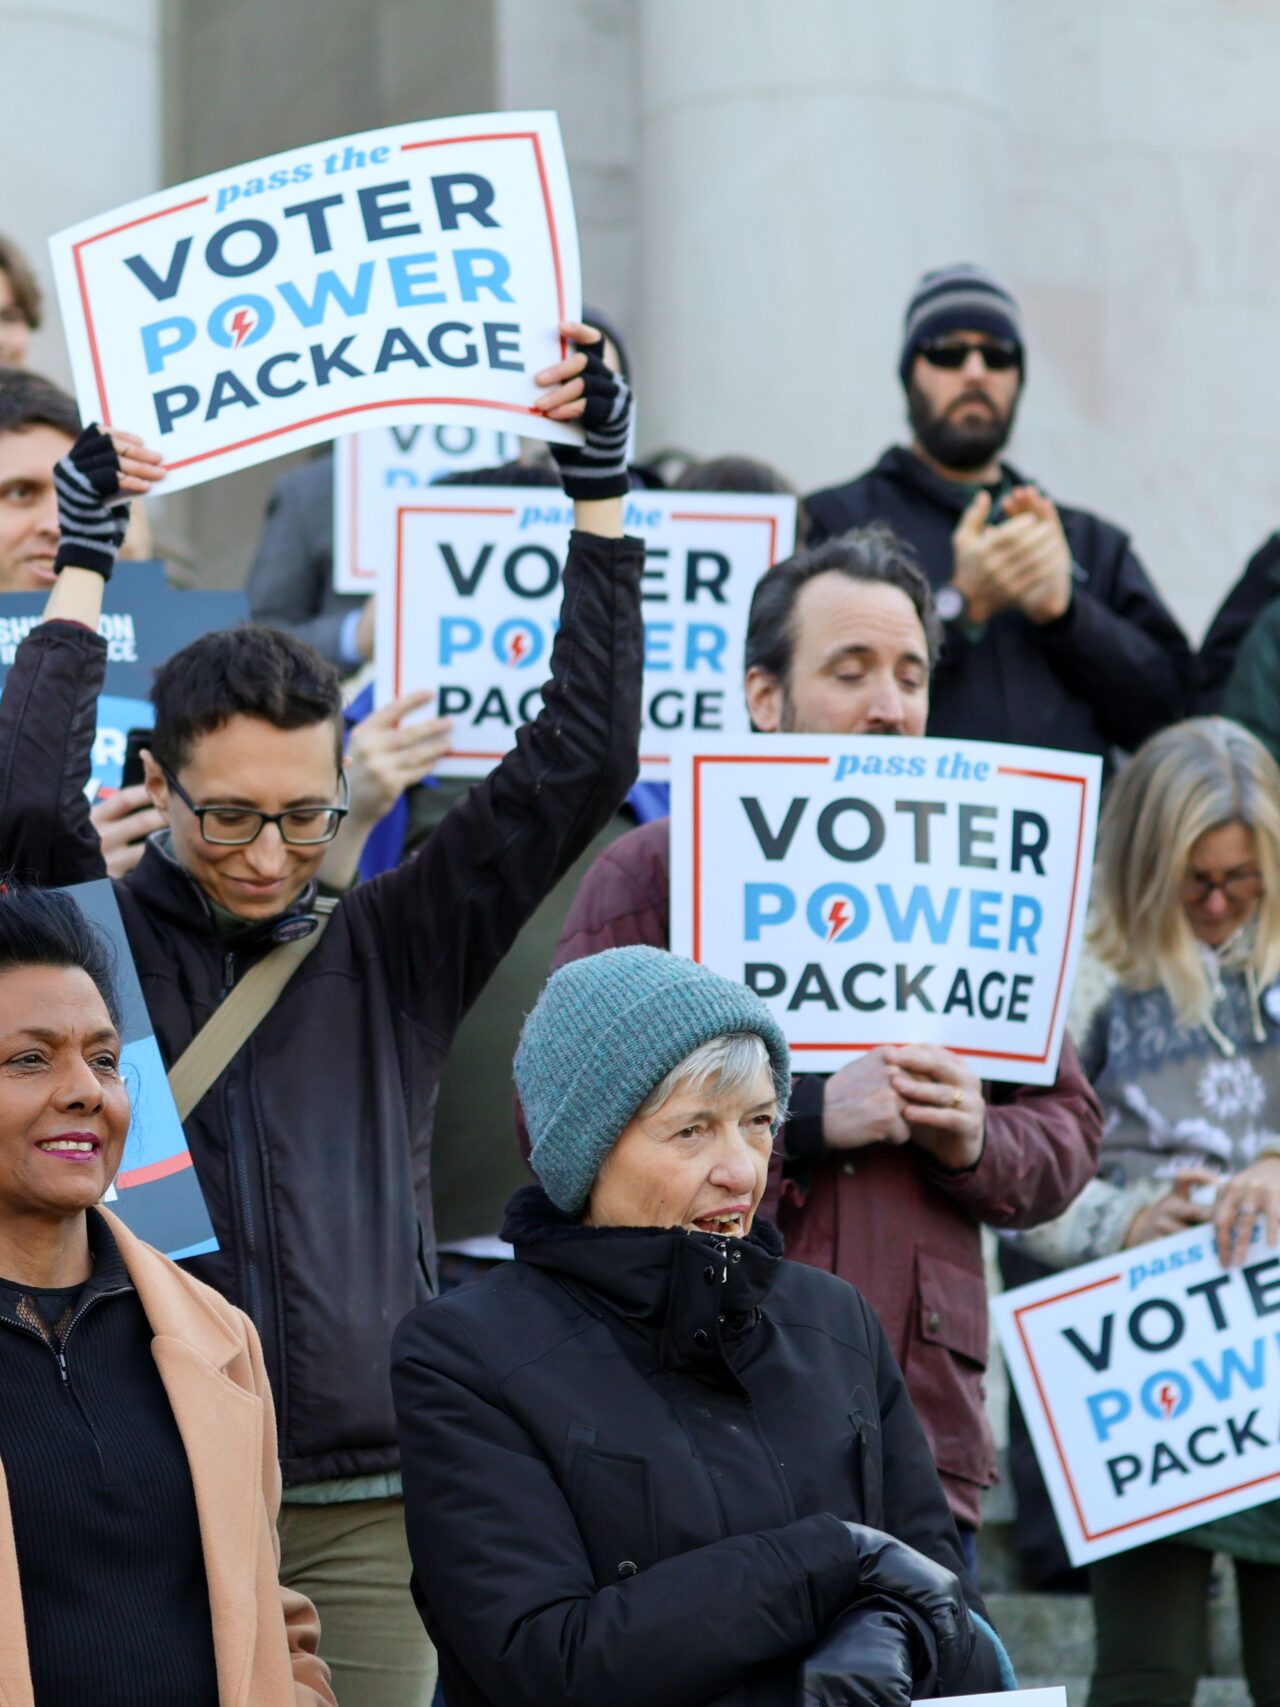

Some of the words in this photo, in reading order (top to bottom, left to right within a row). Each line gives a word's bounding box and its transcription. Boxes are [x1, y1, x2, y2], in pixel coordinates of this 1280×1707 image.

[215, 162, 314, 214] pass
[322, 144, 392, 176] the
[123, 172, 503, 302] VOTER
[139, 247, 517, 376] POWER
[152, 320, 526, 436] PACKAGE
[624, 501, 662, 527] he
[438, 542, 731, 605] VOER
[438, 615, 729, 674] POER
[833, 751, 927, 782] pass
[936, 751, 990, 782] the
[739, 796, 1050, 876] VOTER
[743, 882, 1044, 955] POWER
[743, 962, 1035, 1023] PACKAGE
[1128, 1243, 1205, 1292] pass
[1085, 1331, 1280, 1443] POW
[1105, 1407, 1280, 1498] PACK
